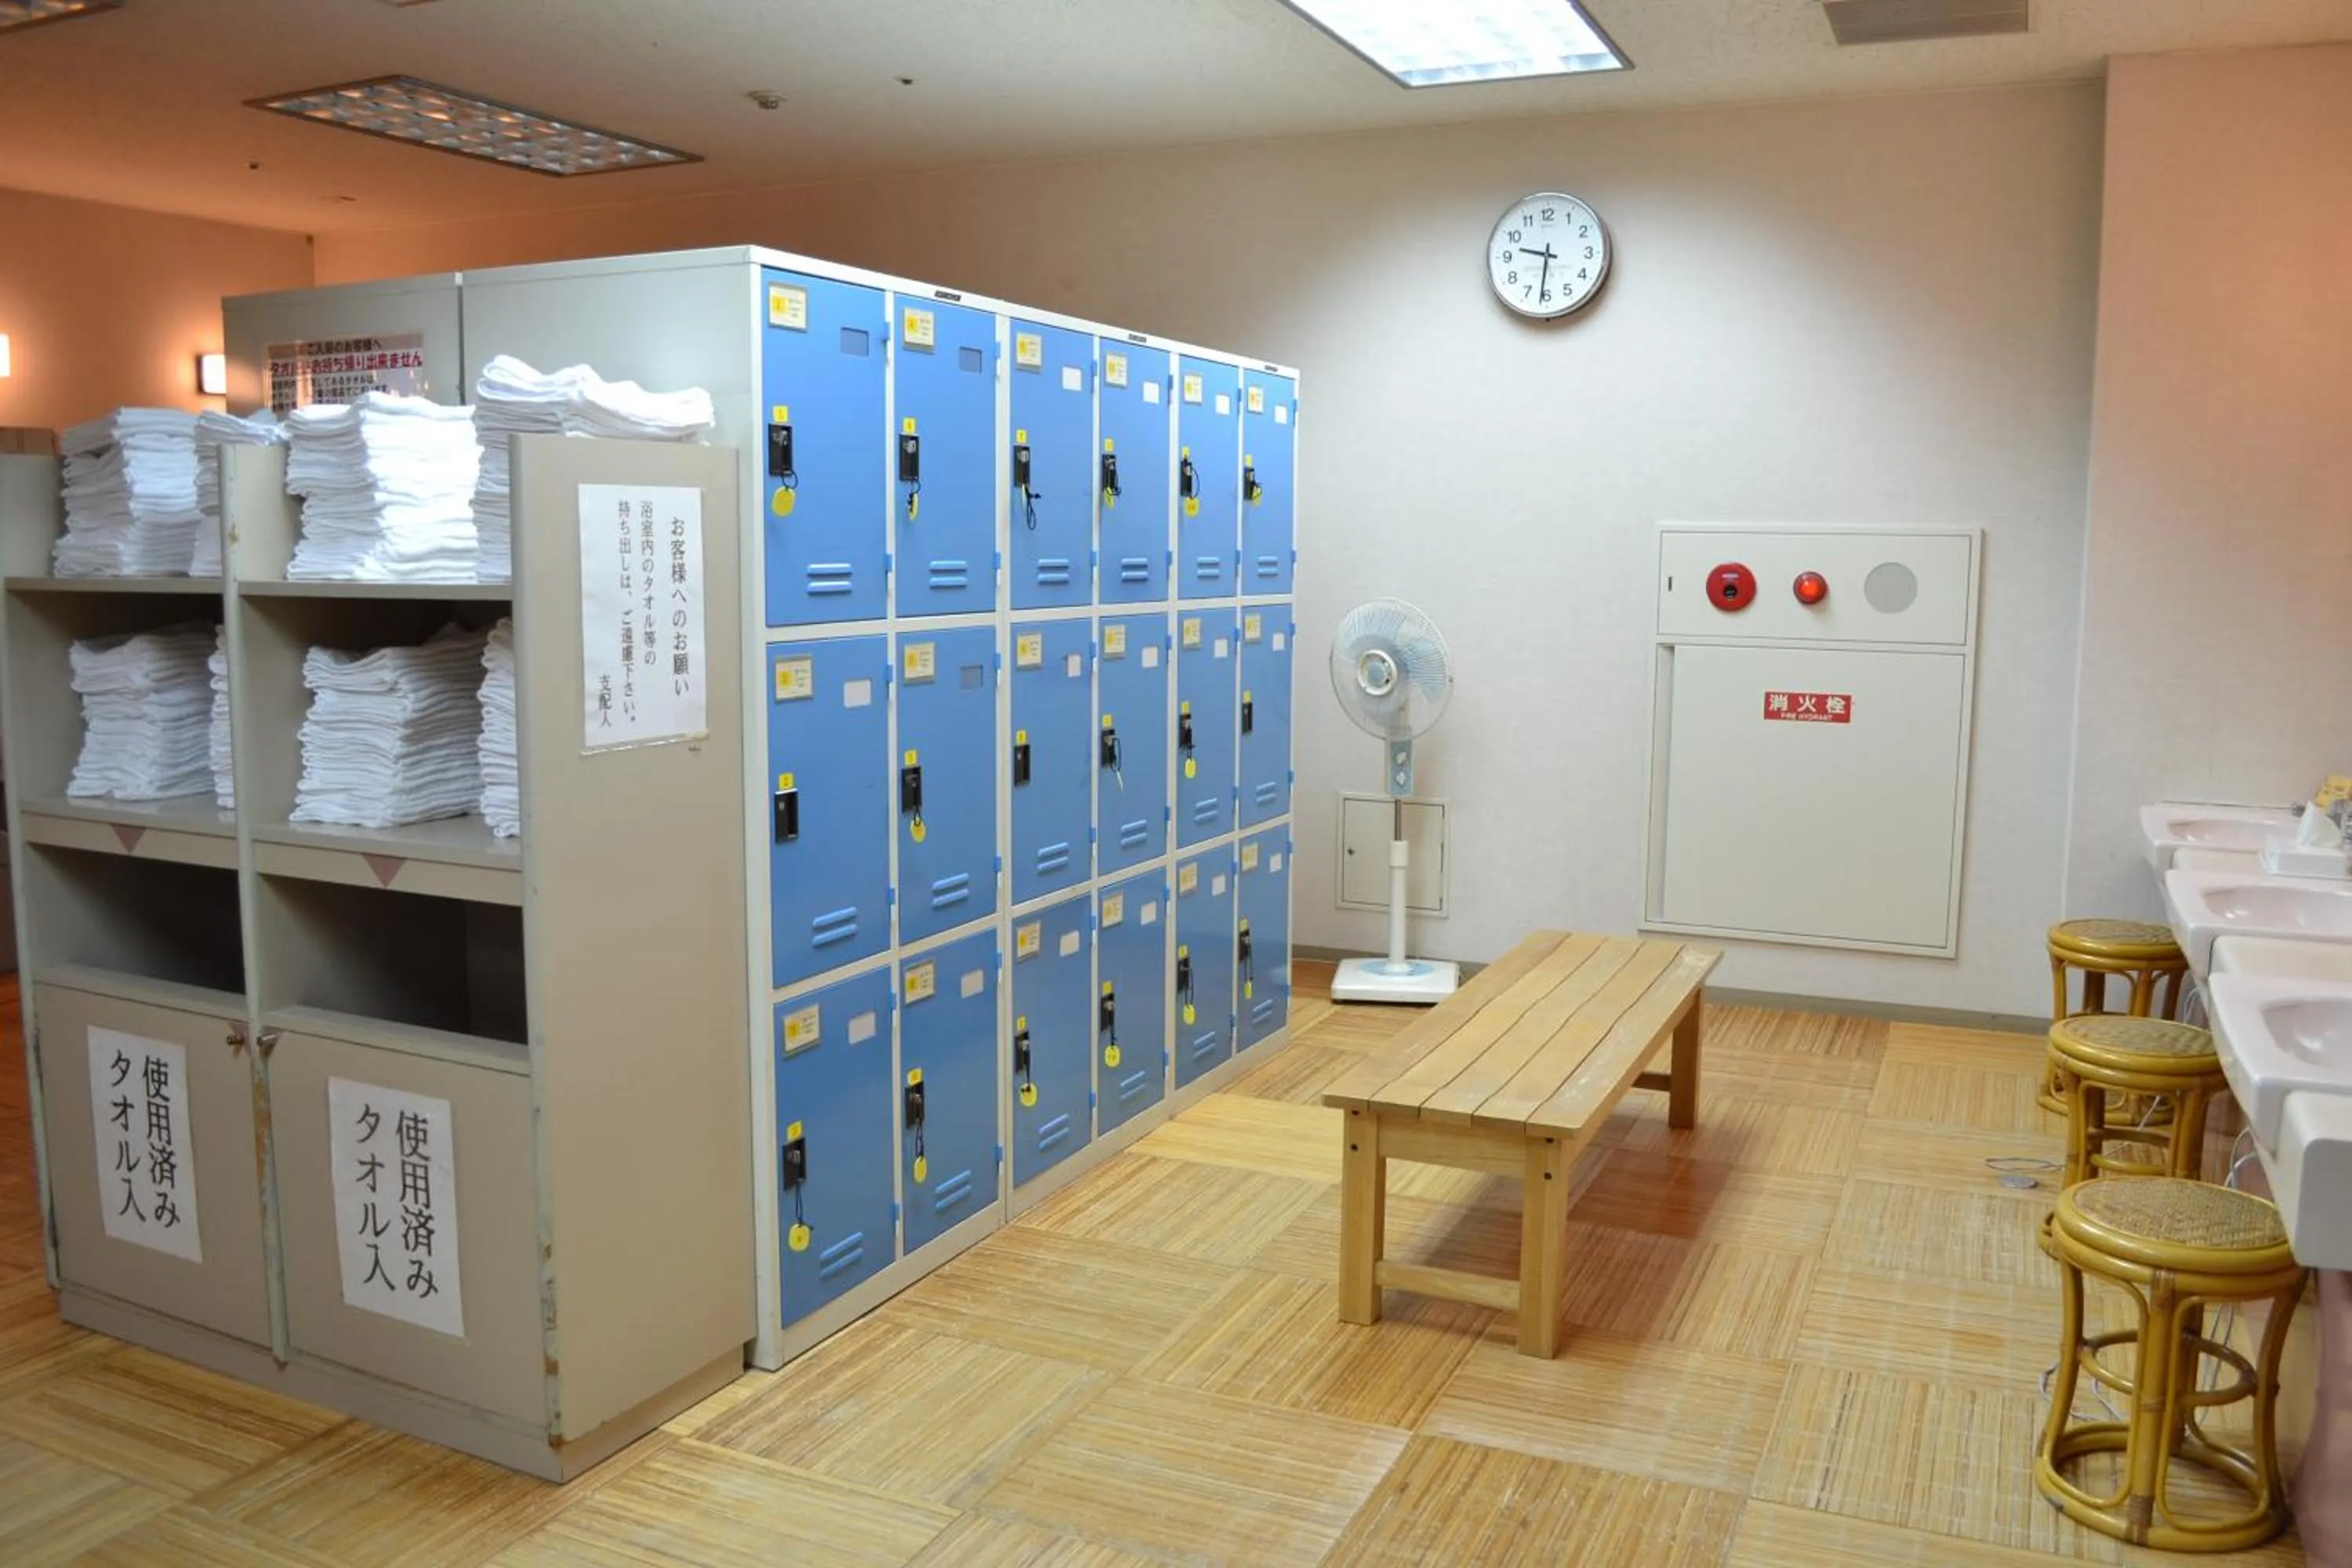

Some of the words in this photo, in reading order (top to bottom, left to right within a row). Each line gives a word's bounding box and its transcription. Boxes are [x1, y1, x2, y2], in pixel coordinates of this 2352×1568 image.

[1523, 215, 1533, 227] 11
[1541, 208, 1555, 222] 12
[1566, 212, 1571, 225] 1
[1508, 230, 1522, 243] 10
[1579, 225, 1588, 238] 2
[1502, 250, 1512, 263] 9
[1584, 245, 1594, 260] 3
[1508, 271, 1518, 284] 8
[1577, 267, 1588, 281] 4
[1523, 285, 1533, 298] 7
[1541, 289, 1552, 302] 6
[1563, 283, 1573, 296] 5
[641, 500, 657, 665] 浴室内のタオル等の
[670, 516, 689, 695] お客様へのお願い
[598, 673, 612, 728] 支配人
[1769, 694, 1846, 713] 消火栓
[111, 1049, 146, 1222] タオル入
[142, 1056, 180, 1228] 使用済み
[356, 1104, 395, 1291] タオル入
[395, 1110, 439, 1298] 使用済み
